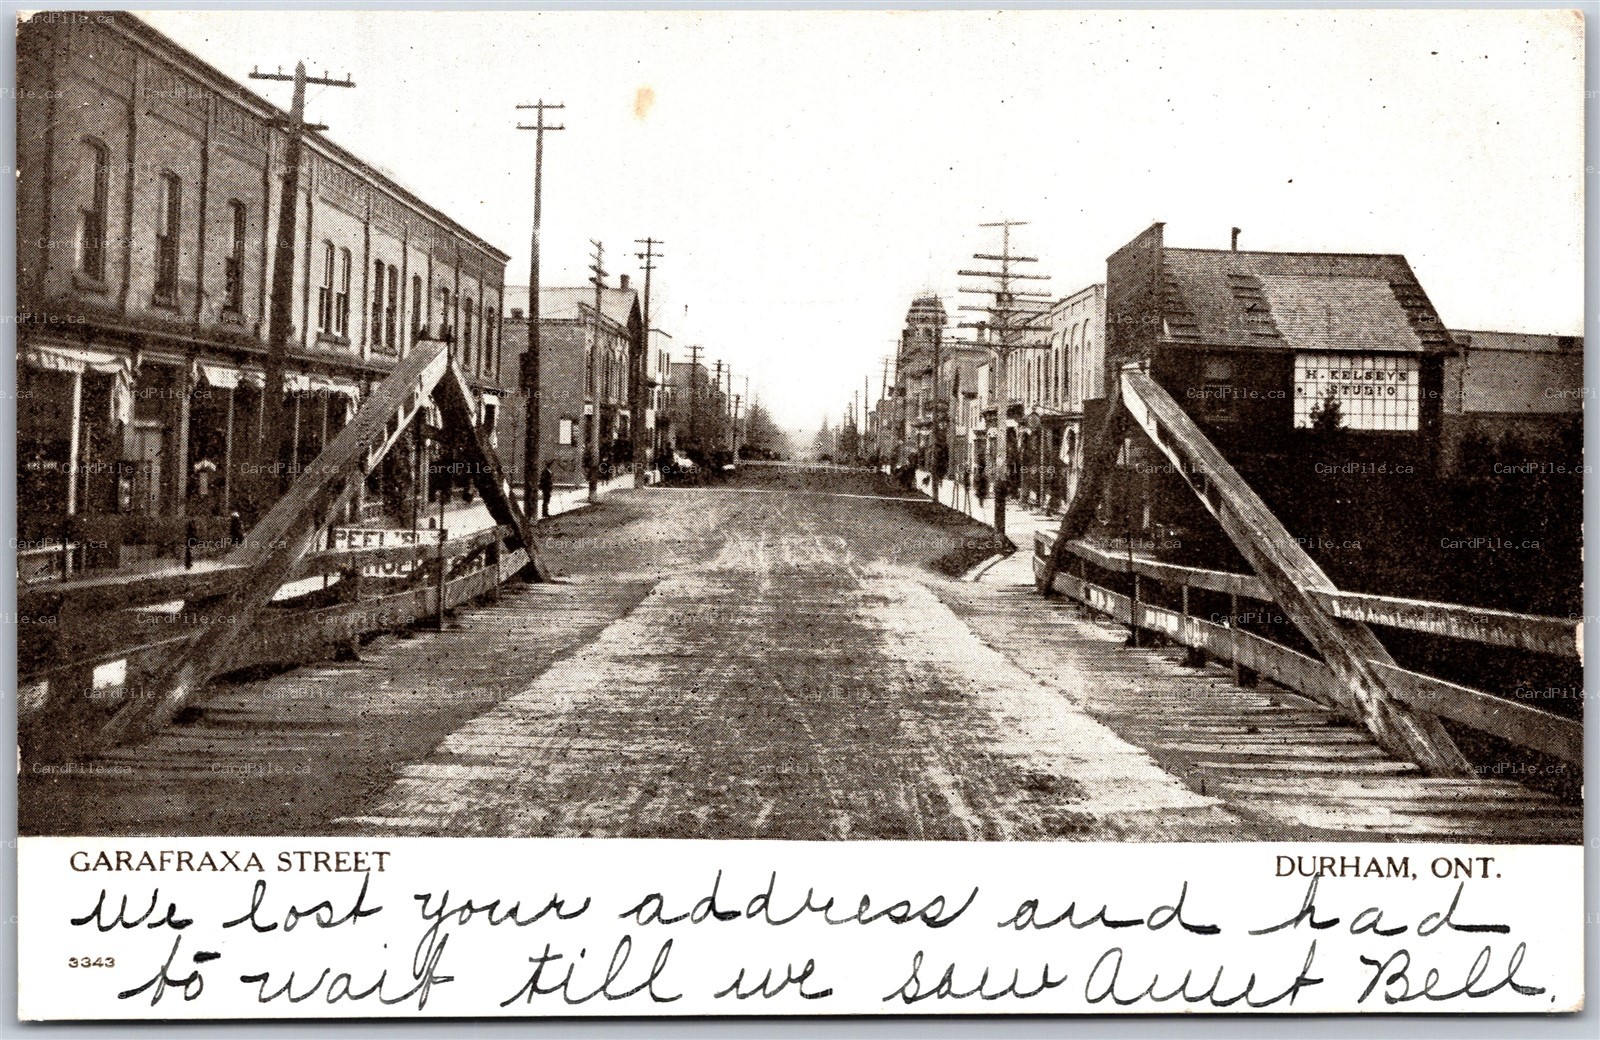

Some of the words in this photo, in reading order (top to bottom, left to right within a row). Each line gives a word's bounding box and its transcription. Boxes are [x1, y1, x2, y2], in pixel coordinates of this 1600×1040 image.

[1330, 385, 1396, 397] STUDIO
[70, 887, 193, 932] We
[223, 872, 383, 932] lost
[414, 890, 592, 978] your
[619, 869, 979, 929] address
[997, 881, 1221, 935] and
[1248, 873, 1510, 935] had
[118, 934, 221, 1006] to
[241, 933, 454, 1010] wait
[500, 934, 683, 1007] till
[714, 958, 833, 999] we
[883, 951, 1067, 1003] saw
